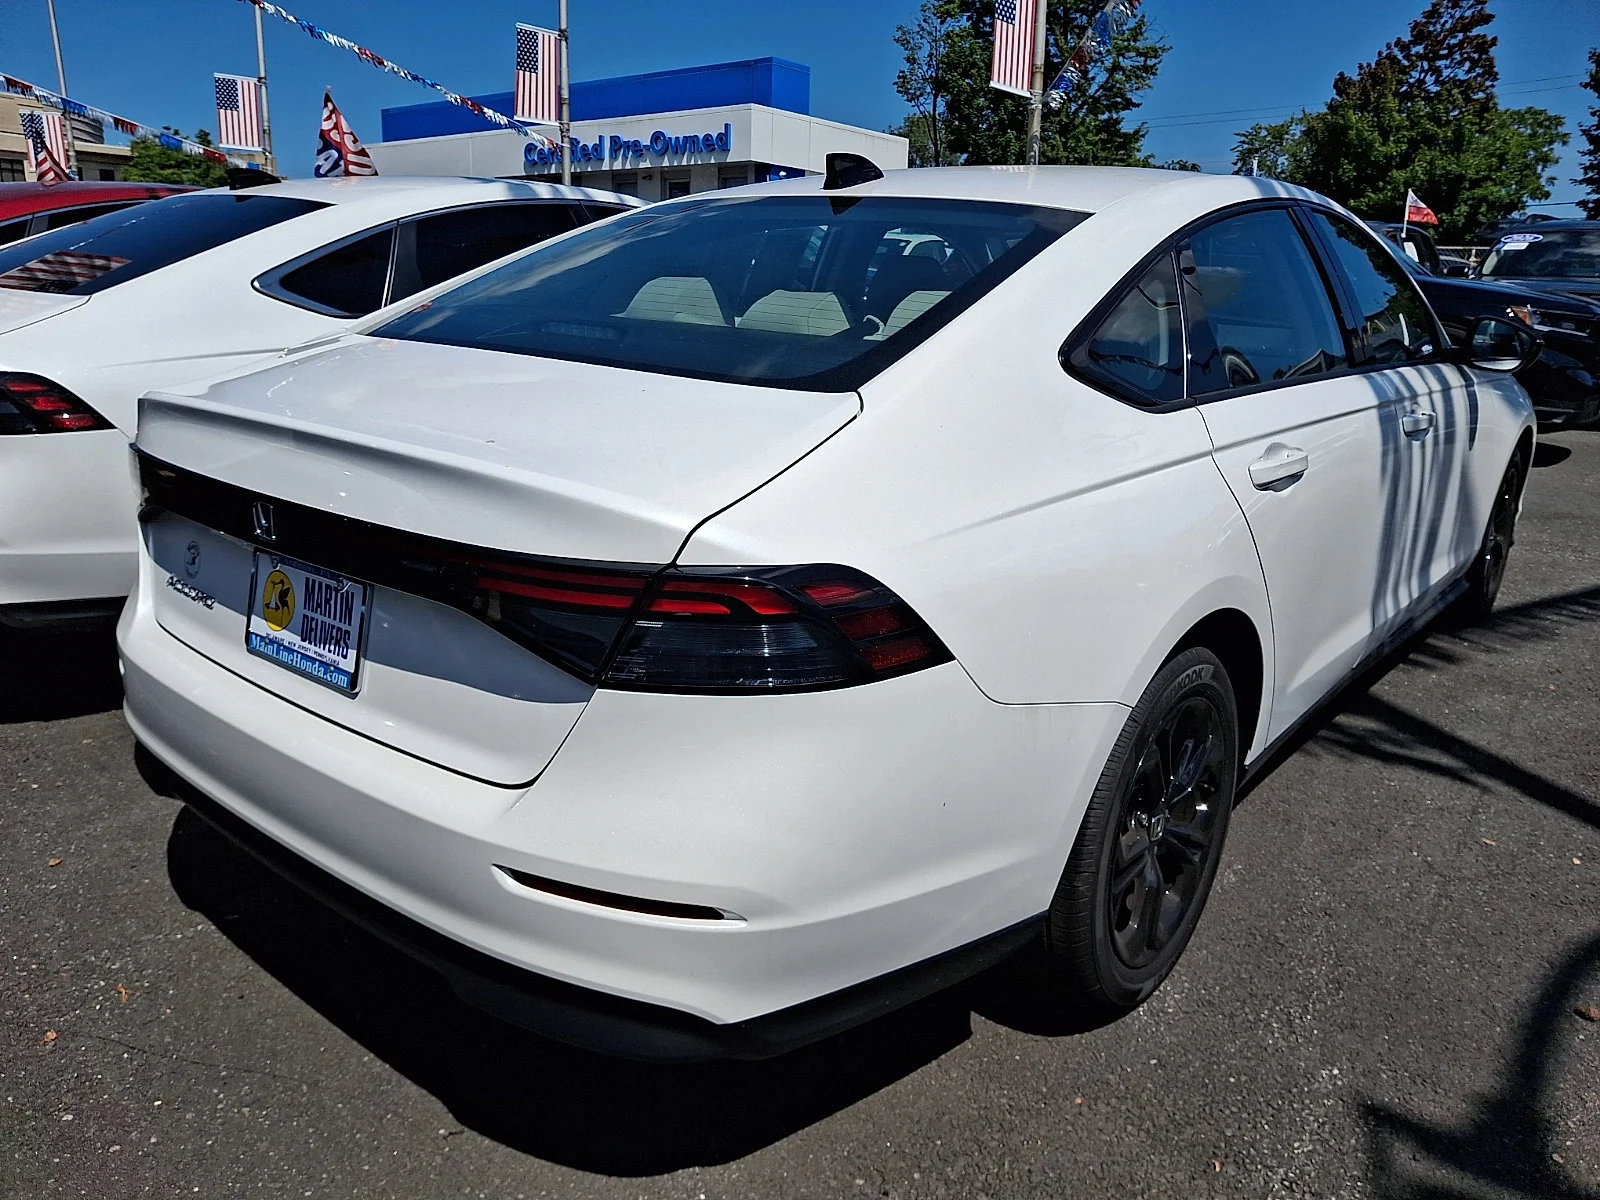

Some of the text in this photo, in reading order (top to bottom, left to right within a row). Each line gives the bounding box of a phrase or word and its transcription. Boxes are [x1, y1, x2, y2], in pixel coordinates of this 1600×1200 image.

[609, 123, 731, 159] Pre-Owned
[303, 576, 355, 627] MARTIN
[250, 633, 349, 689] MainLineHonda.com
[300, 613, 351, 660] DELIVERS
